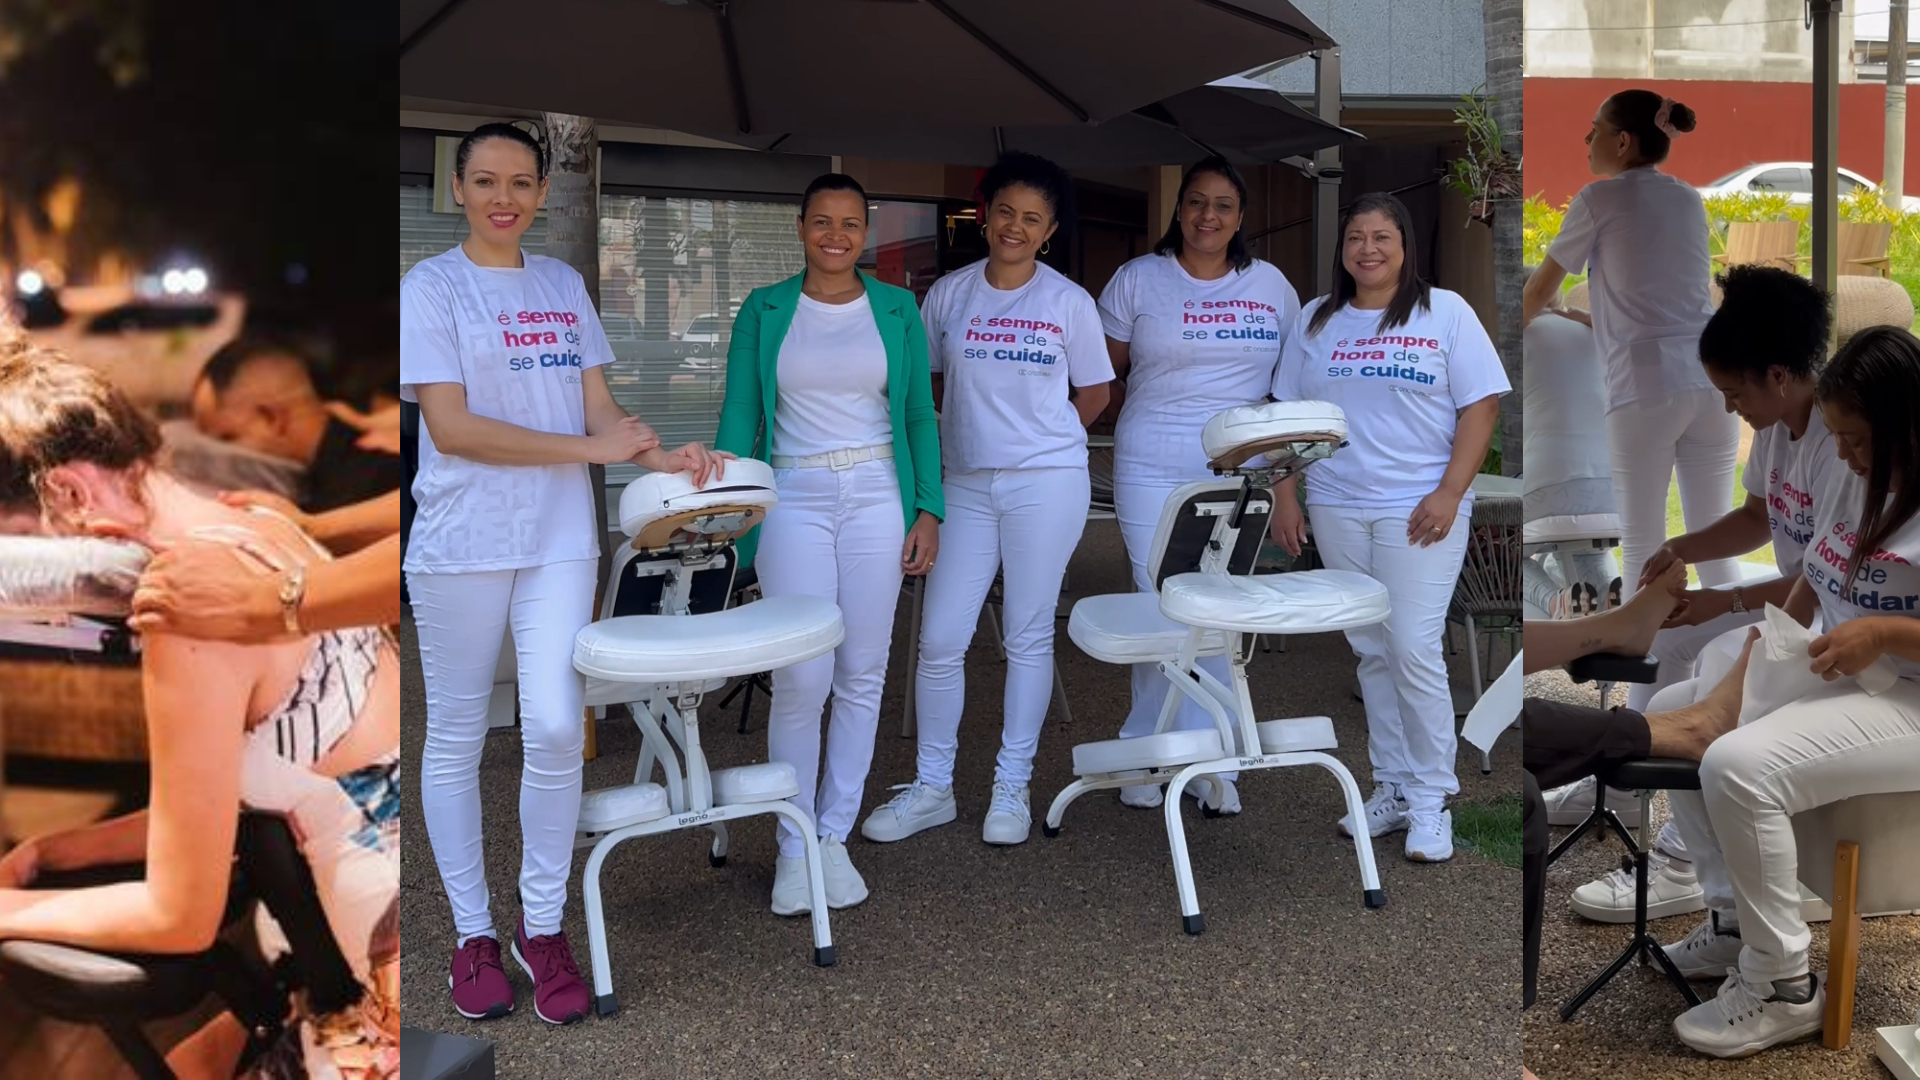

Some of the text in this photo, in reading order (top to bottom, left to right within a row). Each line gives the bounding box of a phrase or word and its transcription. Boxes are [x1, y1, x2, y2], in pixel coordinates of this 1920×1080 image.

[1183, 299, 1277, 313] é sempre
[497, 310, 511, 326] é
[970, 315, 1063, 334] é sempre
[1183, 312, 1266, 324] hora de
[502, 330, 558, 347] hora
[965, 329, 1047, 346] hora de
[1182, 327, 1278, 340] se cuidar
[1337, 335, 1439, 350] é sempre
[509, 356, 535, 371] se
[964, 348, 1057, 365] se cuidar
[1331, 349, 1419, 363] hora de
[1327, 364, 1436, 385] se cuidar
[1794, 510, 1815, 527] de
[1832, 520, 1849, 535] é
[1814, 536, 1887, 584] hora de
[1806, 562, 1825, 584] se
